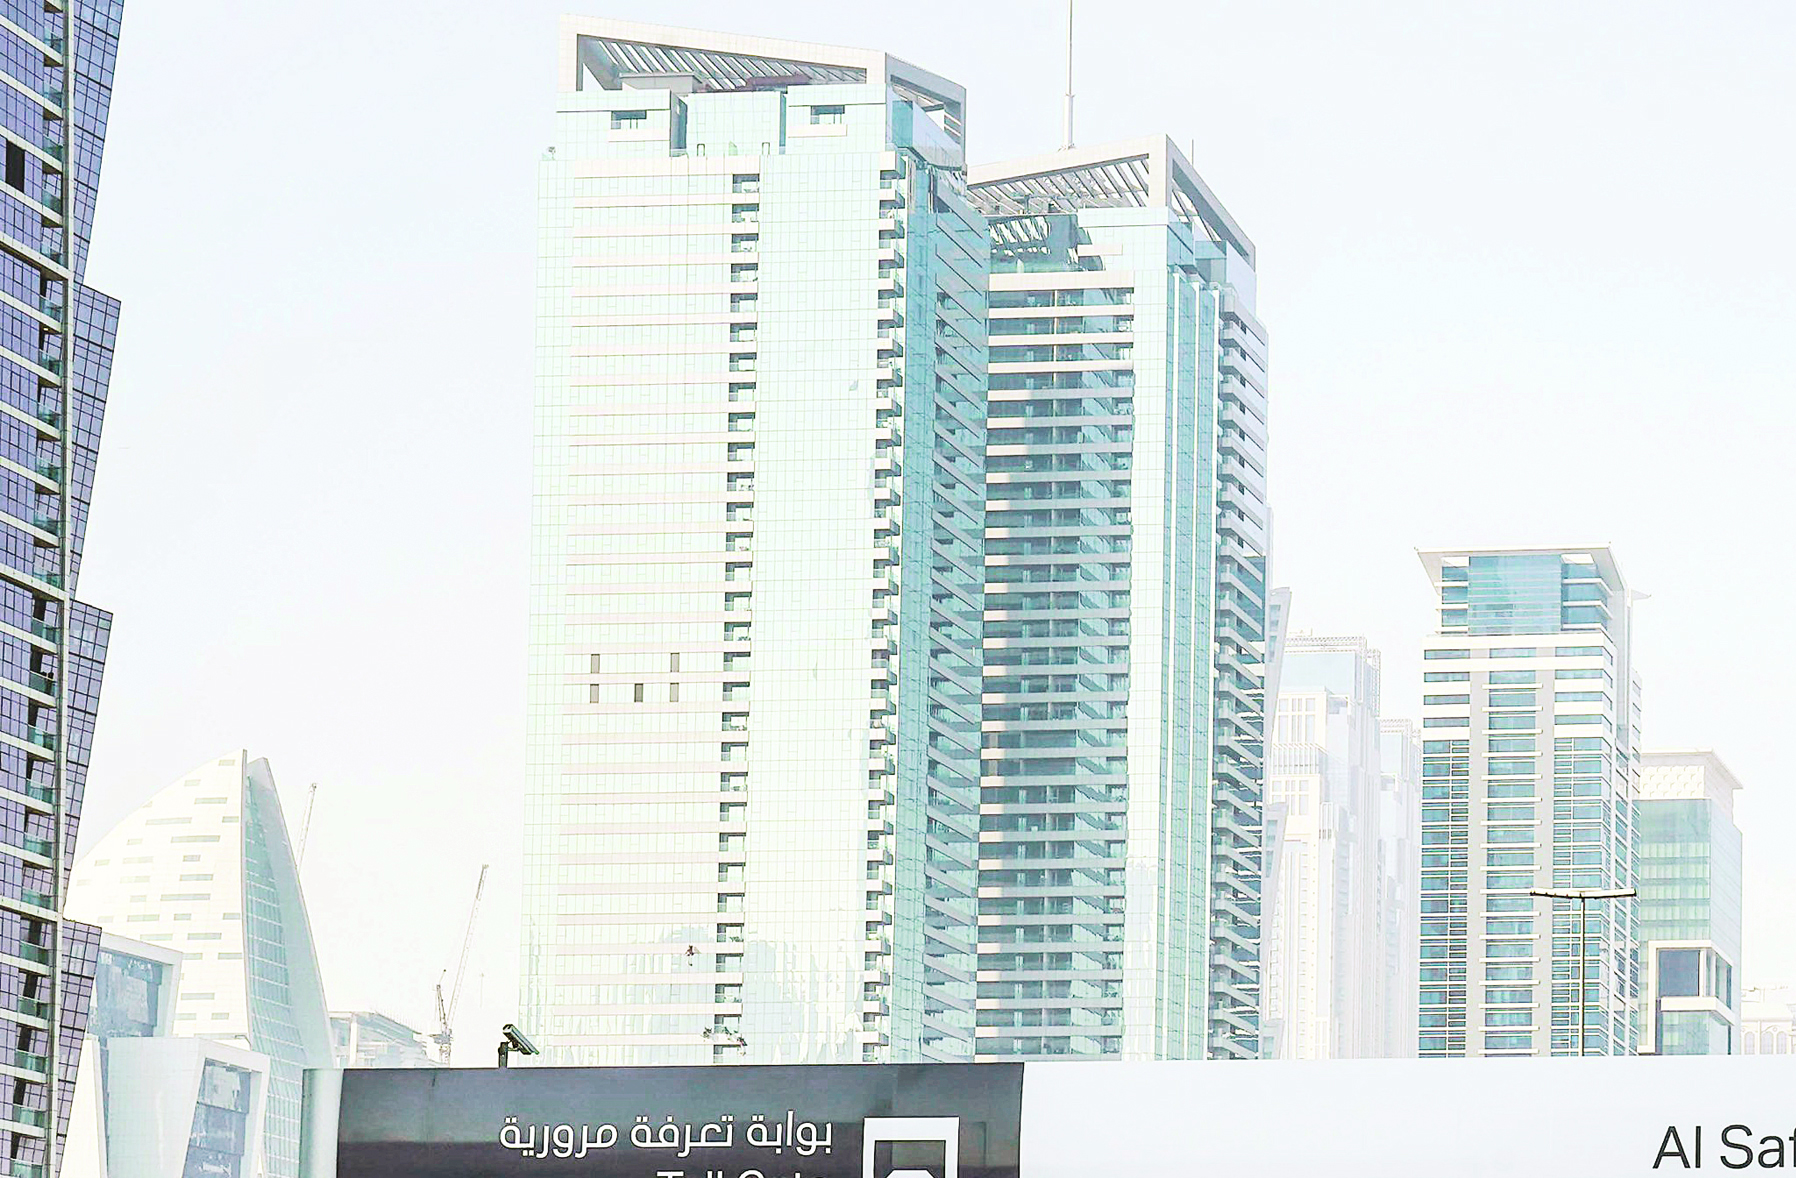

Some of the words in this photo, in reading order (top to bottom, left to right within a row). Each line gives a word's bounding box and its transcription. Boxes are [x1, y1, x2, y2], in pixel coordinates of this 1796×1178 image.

[499, 1115, 618, 1158] مرورية
[630, 1114, 736, 1158] تعرفة
[745, 1109, 833, 1155] بوابة
[1652, 1125, 1702, 1169] Al
